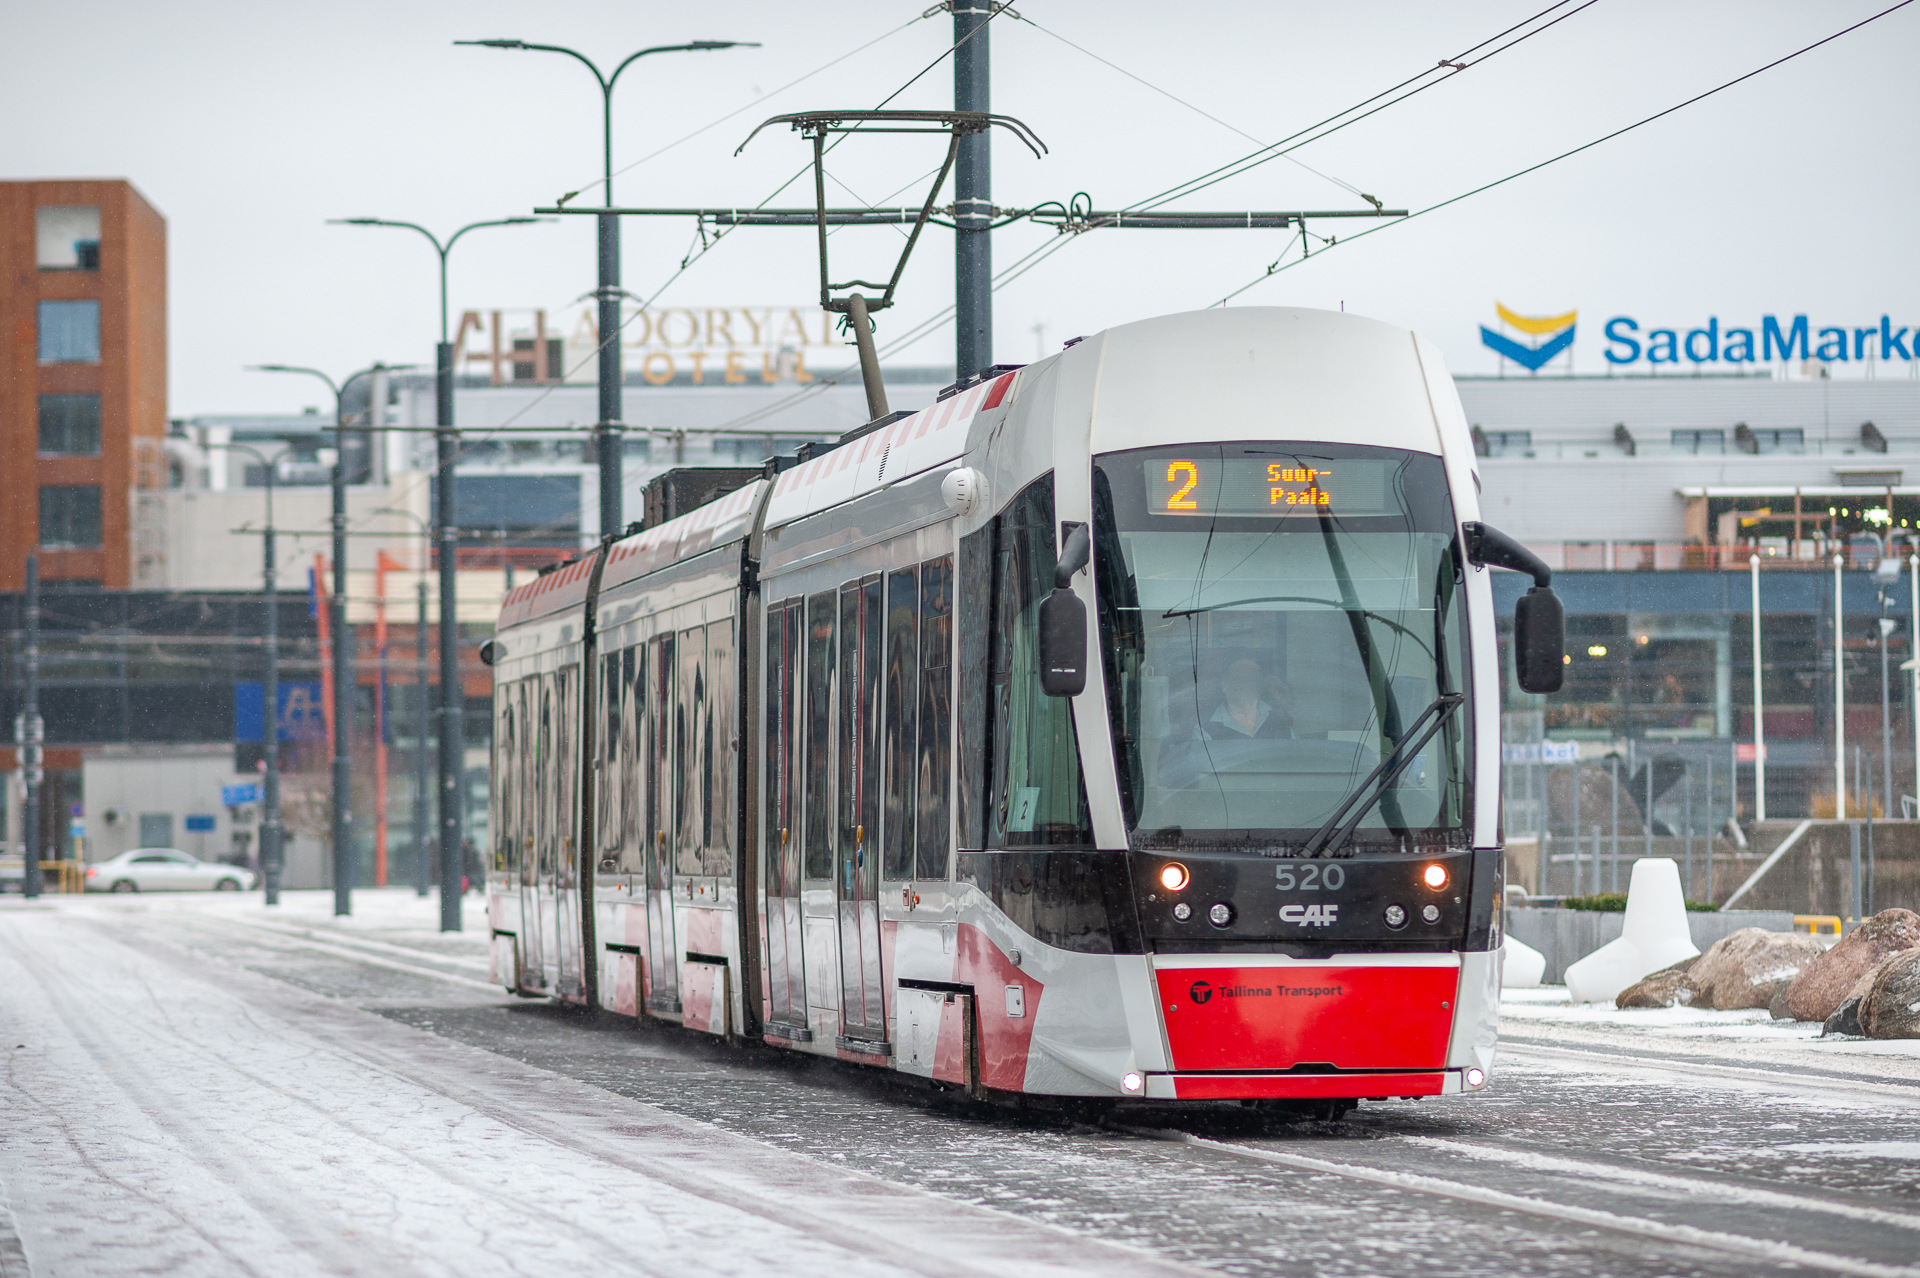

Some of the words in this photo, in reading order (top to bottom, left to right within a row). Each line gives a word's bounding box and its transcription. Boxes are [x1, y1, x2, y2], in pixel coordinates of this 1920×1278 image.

[1603, 314, 1920, 364] SadaMark
[620, 352, 815, 385] OTELL
[1267, 463, 1332, 482] Suur-
[1167, 461, 1198, 509] 2
[1270, 487, 1330, 505] Paala
[1020, 800, 1028, 820] 2
[1275, 864, 1345, 891] 520
[1278, 904, 1339, 927] CAF
[1219, 986, 1272, 998] Tallinna
[1276, 985, 1343, 998] Transport
